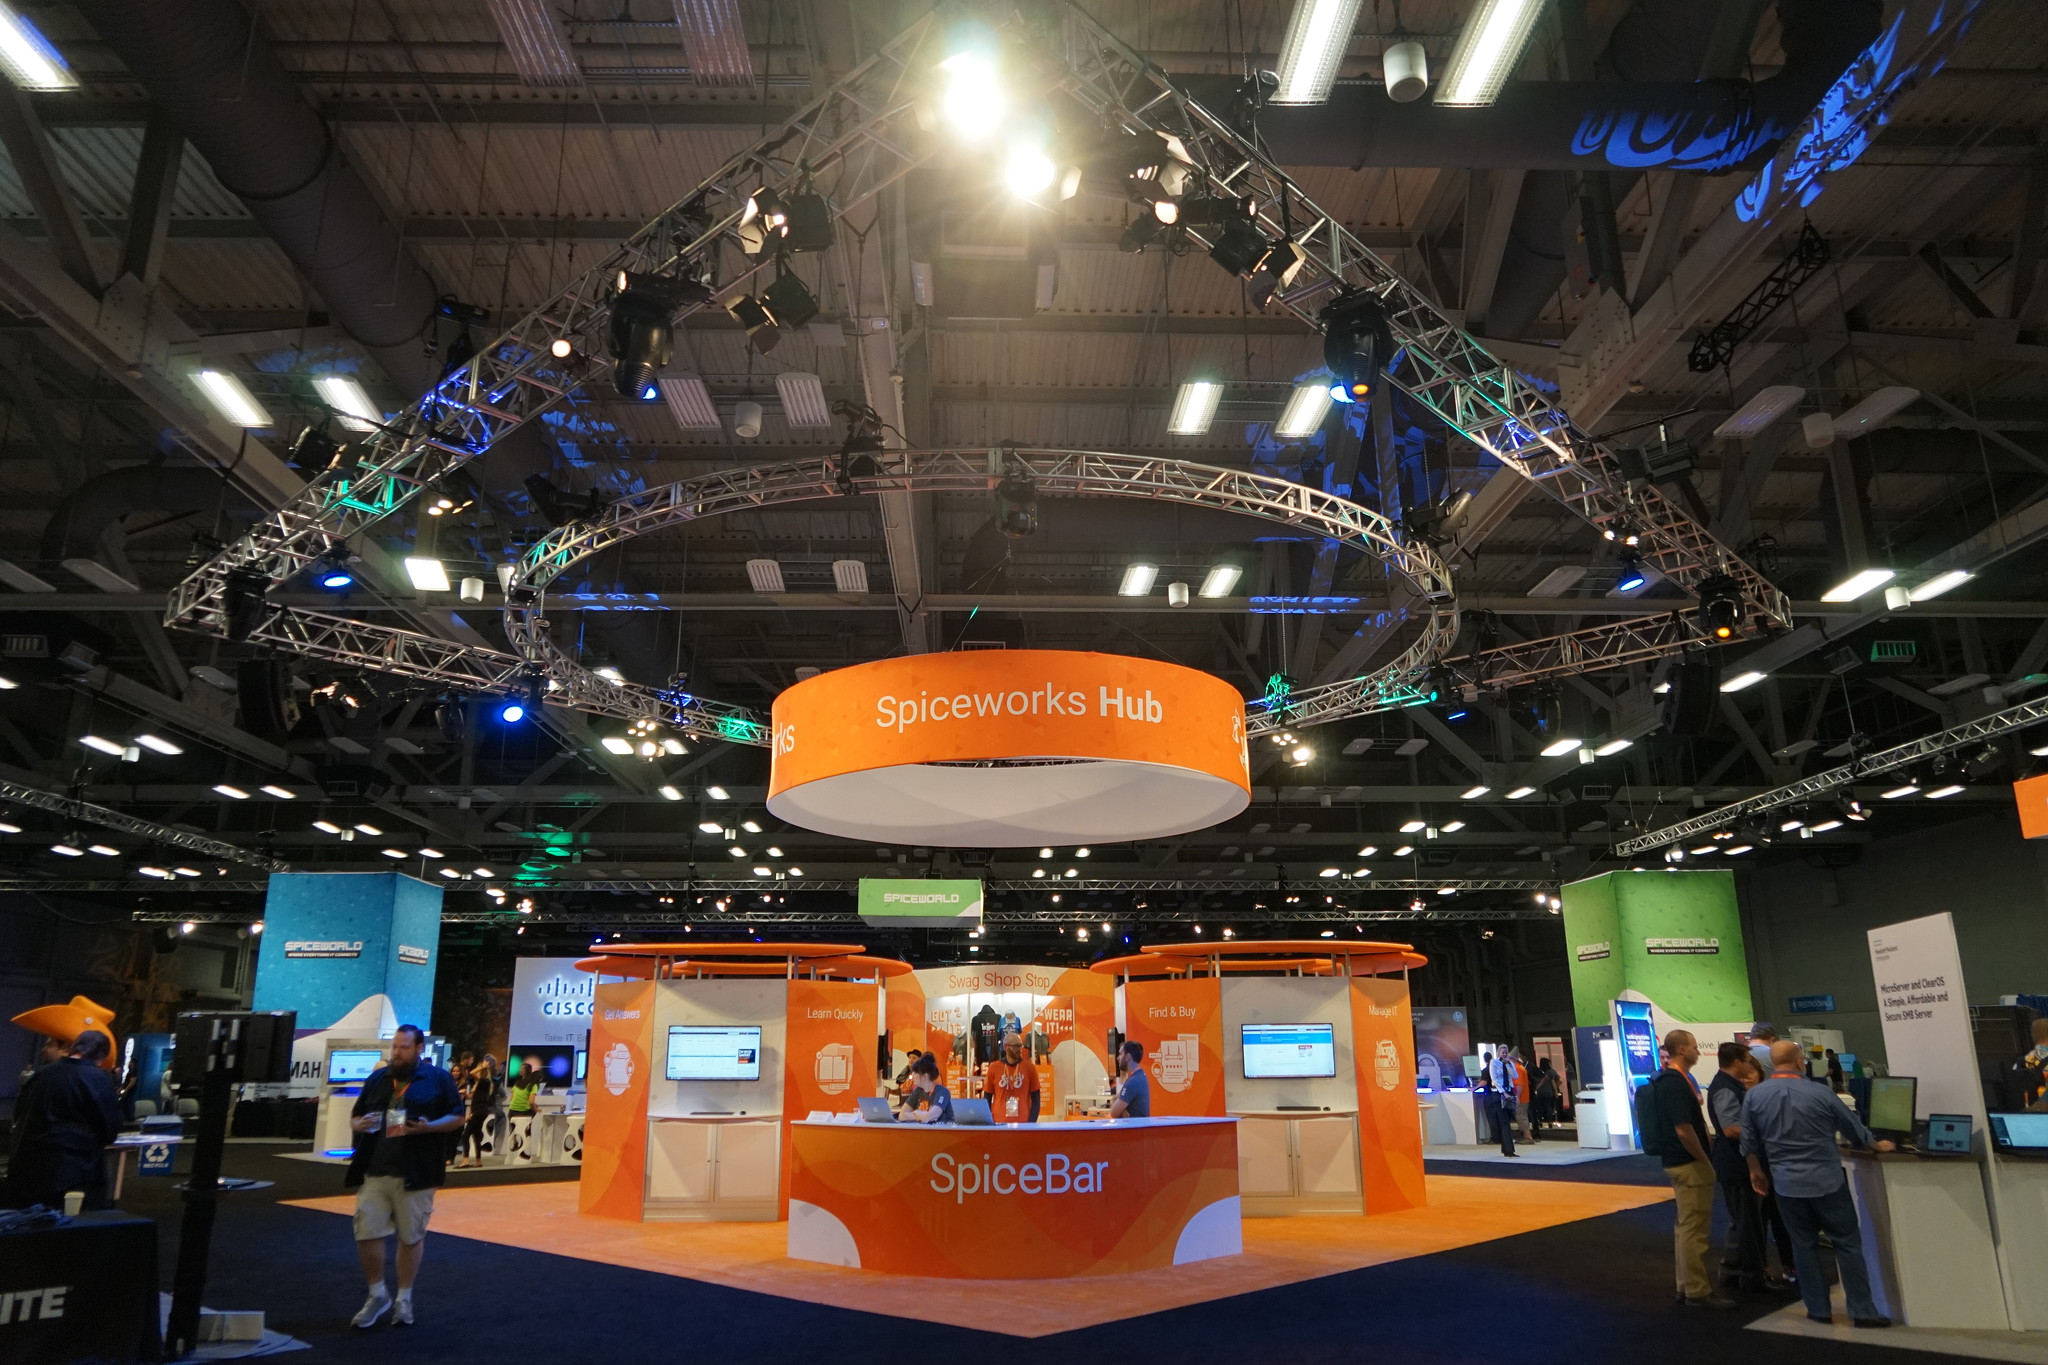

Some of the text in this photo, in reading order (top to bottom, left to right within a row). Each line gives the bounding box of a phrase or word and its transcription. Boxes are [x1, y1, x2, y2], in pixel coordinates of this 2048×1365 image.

[876, 682, 1163, 733] Spiceworks Hub
[883, 893, 959, 903] SPICEWORLD
[285, 941, 363, 951] SPICEWORLD
[1645, 938, 1720, 947] SPICEWORLD
[949, 972, 1050, 991] Swag Shop Stop
[1880, 976, 1945, 994] MicroServer and ClearOS
[1907, 992, 1936, 1005] Affordable
[1937, 990, 1949, 1002] and
[604, 1009, 641, 1020] Get Answers
[807, 1008, 864, 1022] Learn Quickly
[1044, 1009, 1073, 1021] WEAR
[1149, 1006, 1196, 1019] Find & Buy
[1368, 1005, 1392, 1018] Manage
[1392, 1005, 1398, 1016] IT
[1885, 1009, 1933, 1022] Secure SMB Server
[1046, 1022, 1060, 1034] IT!
[544, 1033, 563, 1042] Take
[565, 1033, 574, 1042] IT
[930, 1152, 1109, 1204] SpiceBar
